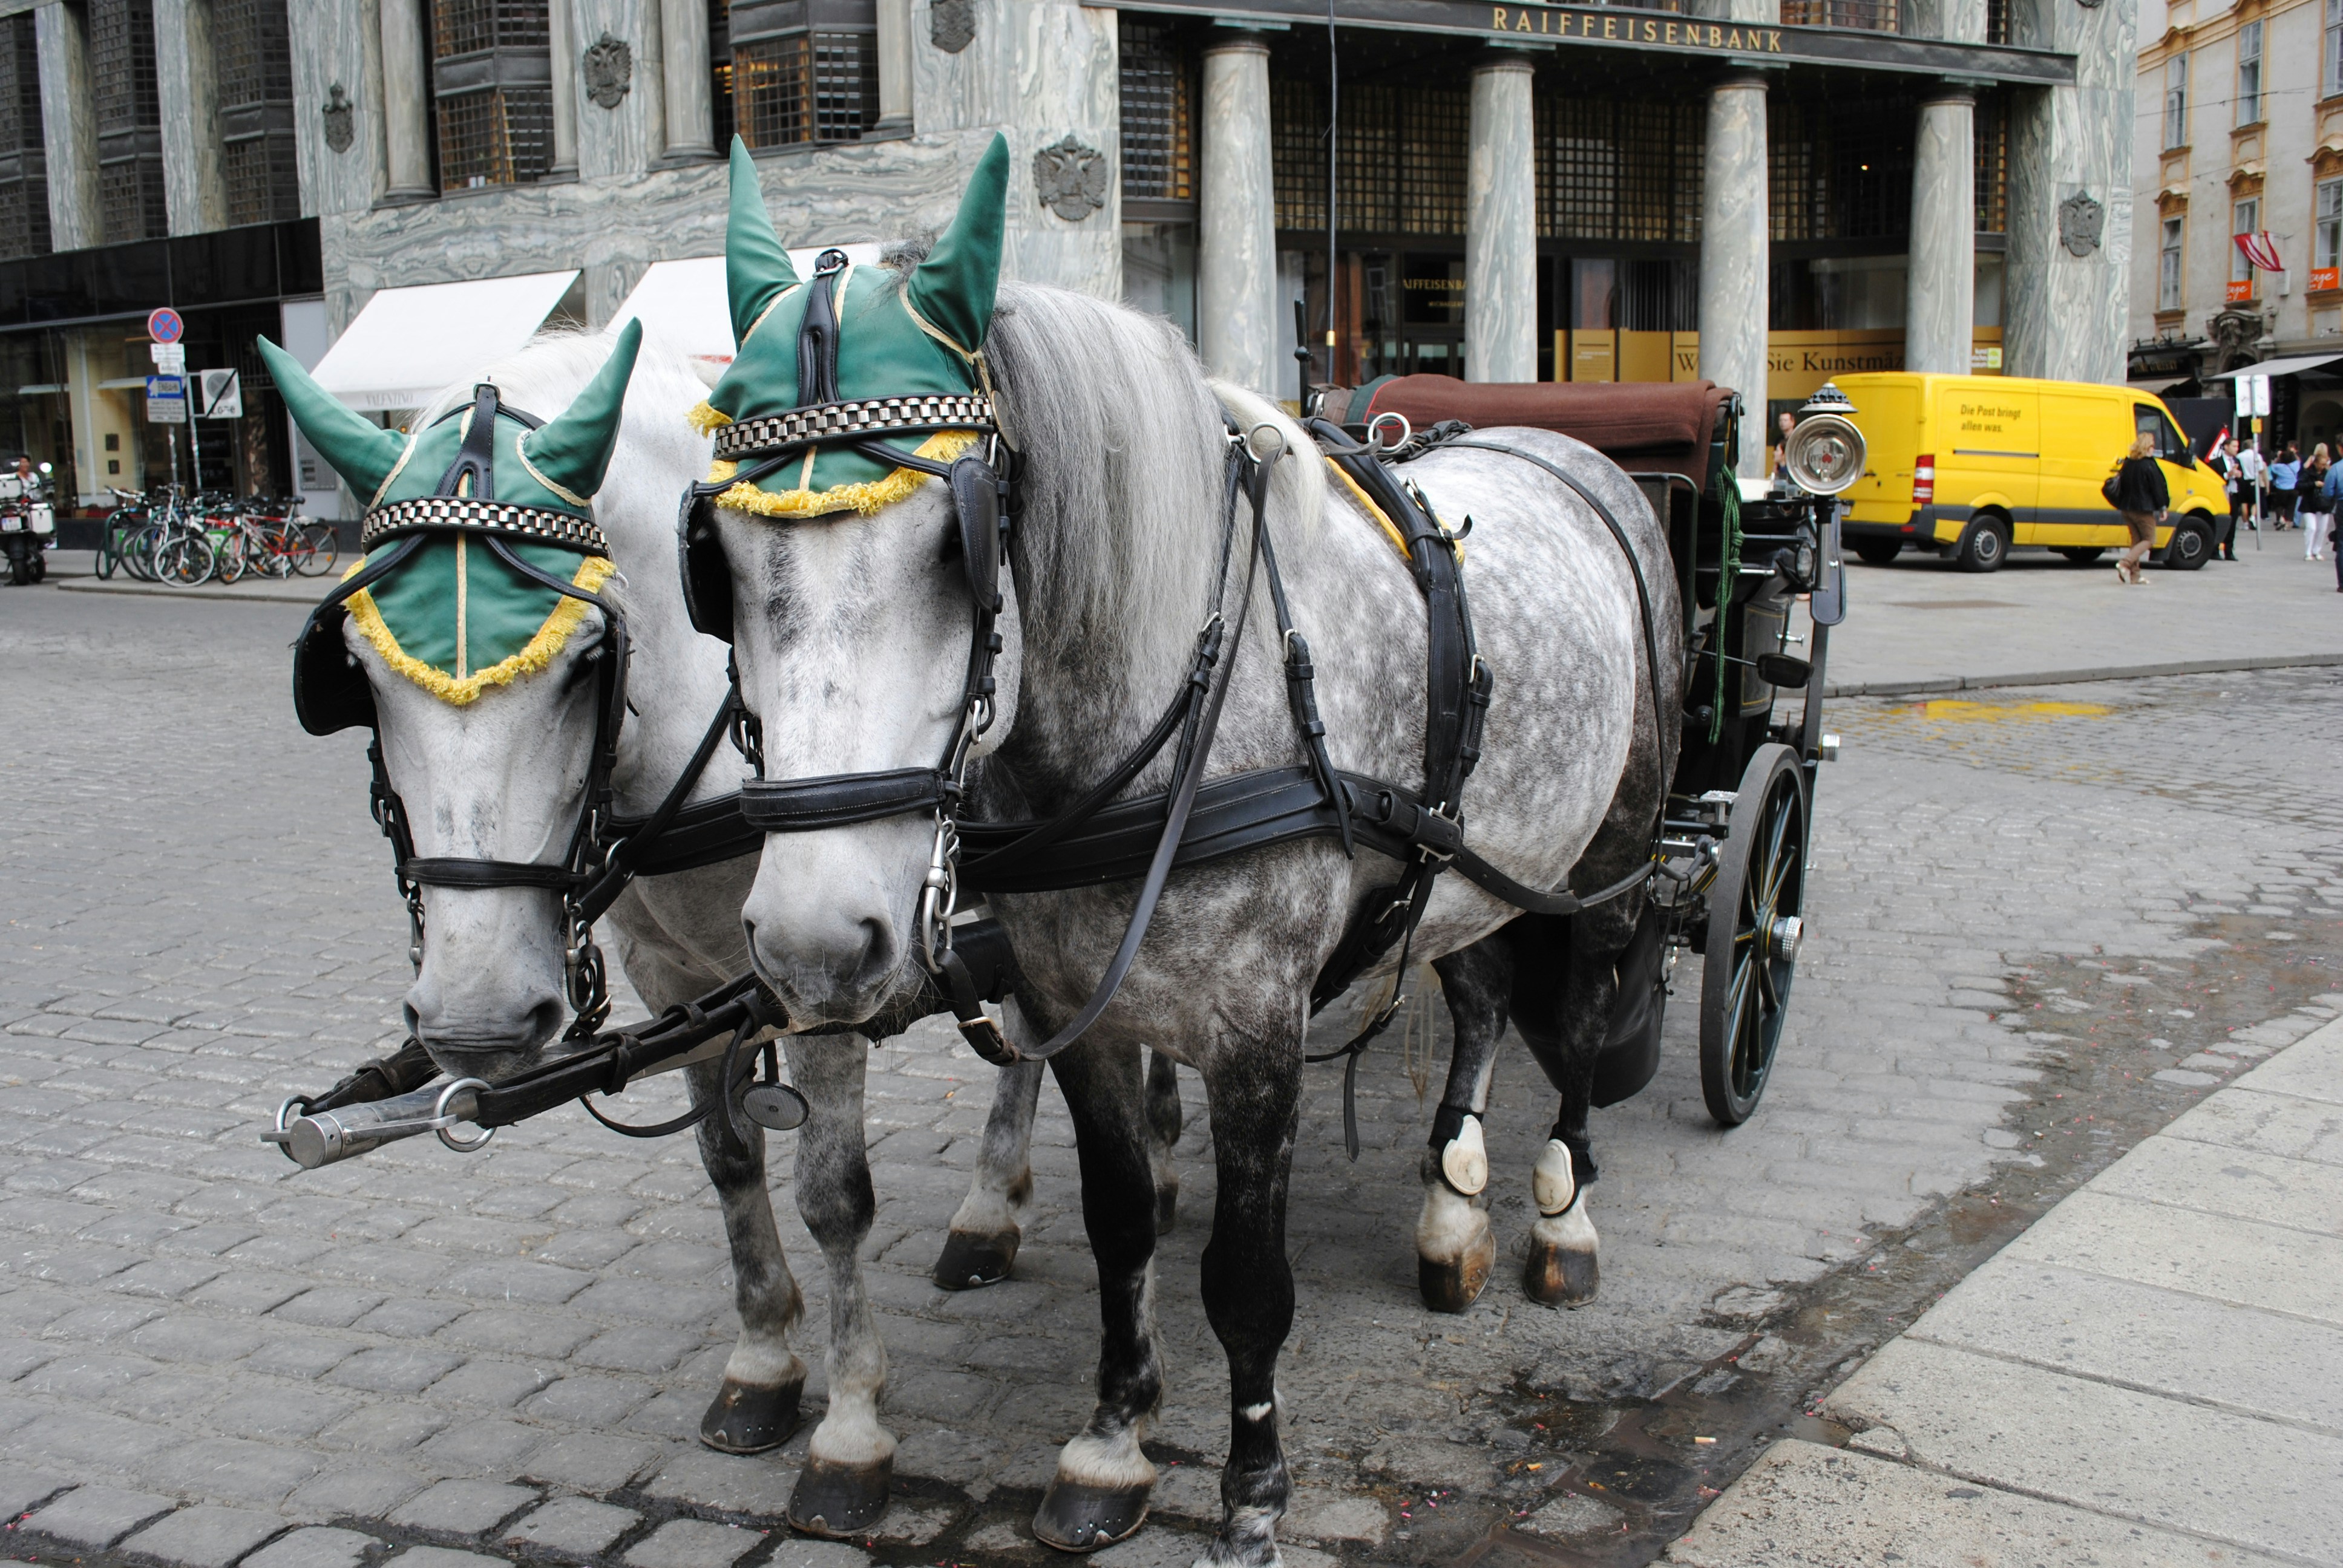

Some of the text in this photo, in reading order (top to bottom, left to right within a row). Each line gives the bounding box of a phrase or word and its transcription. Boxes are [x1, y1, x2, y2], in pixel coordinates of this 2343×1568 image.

[1493, 8, 1781, 52] RAIFFEISENBANK
[1803, 351, 1905, 371] Kunstmäz
[1961, 403, 2021, 420] Die Post bringt
[1961, 420, 2003, 433] allen was.
